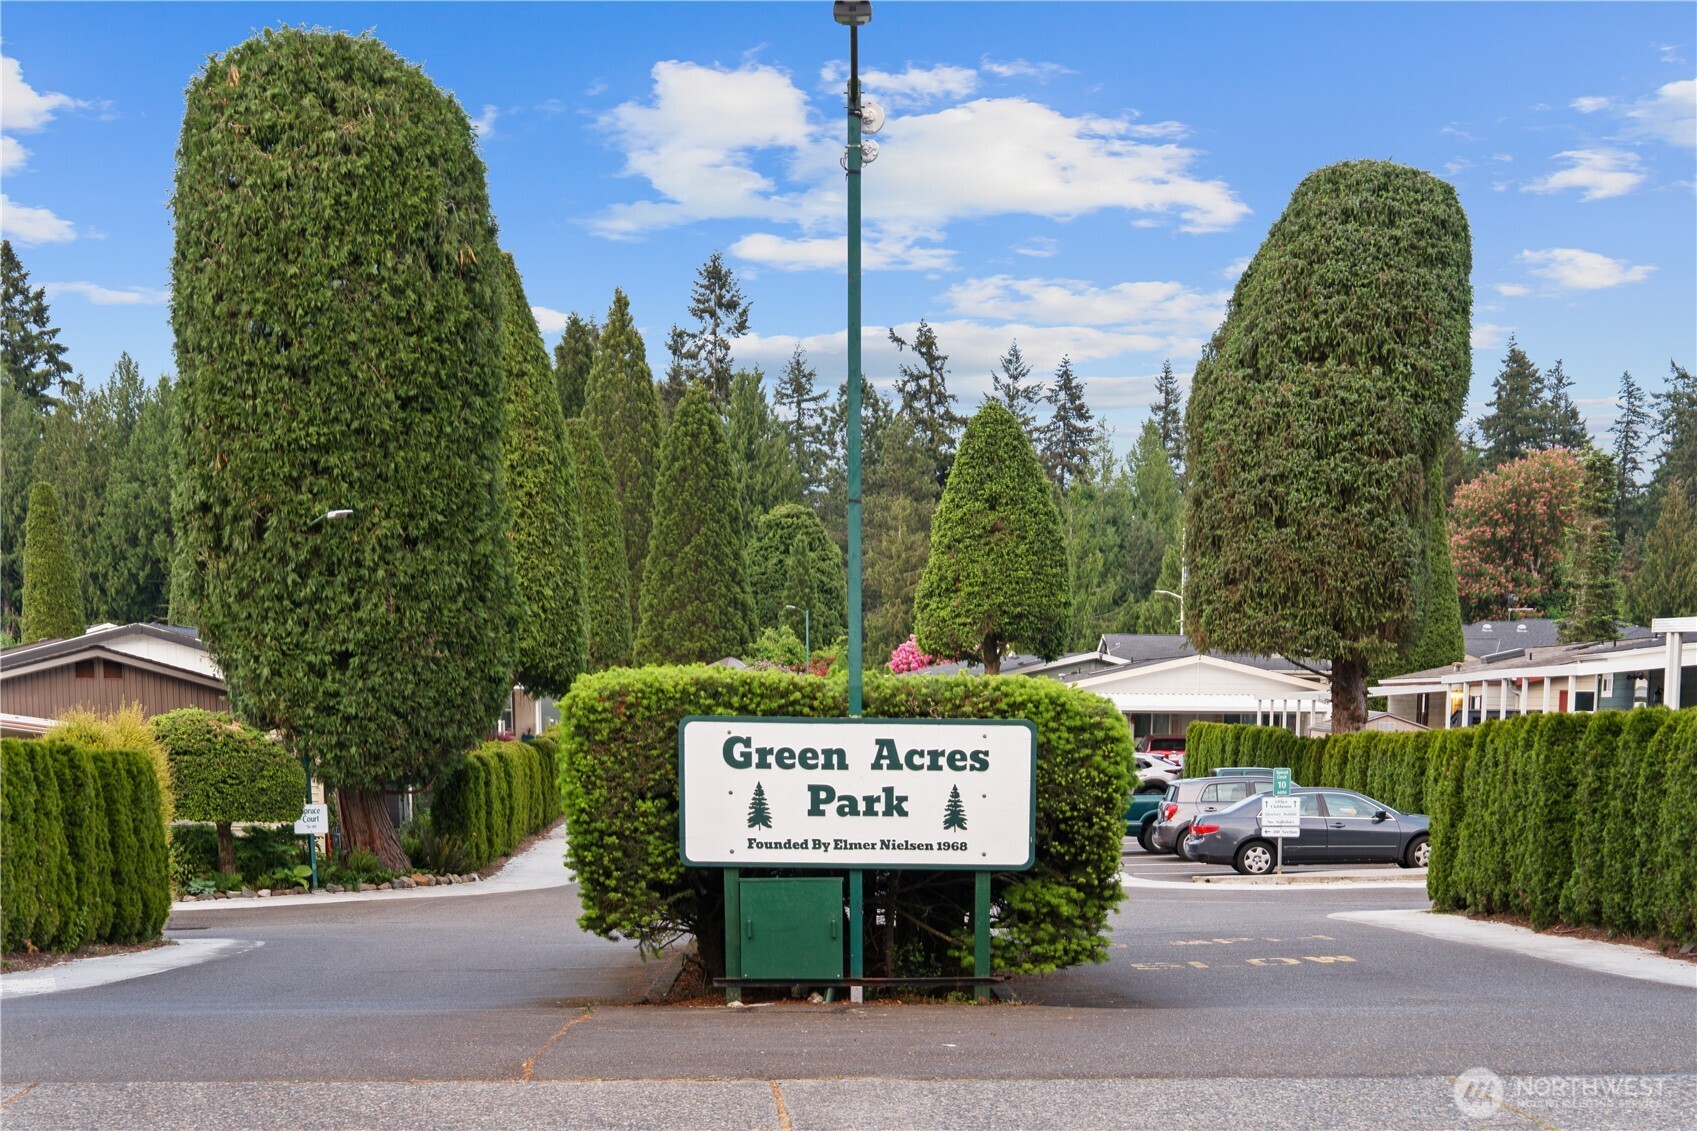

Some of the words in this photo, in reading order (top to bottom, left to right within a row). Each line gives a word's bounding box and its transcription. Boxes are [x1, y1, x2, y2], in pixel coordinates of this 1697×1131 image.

[722, 735, 849, 770] Green
[870, 738, 990, 772] Acres
[1278, 781, 1287, 789] 10
[807, 784, 909, 817] Park
[303, 815, 319, 823] Court
[747, 838, 809, 850] Founded
[811, 839, 831, 852] By
[833, 839, 878, 850] Elmer
[879, 839, 934, 851] Nielsen
[936, 841, 968, 851] 1968
